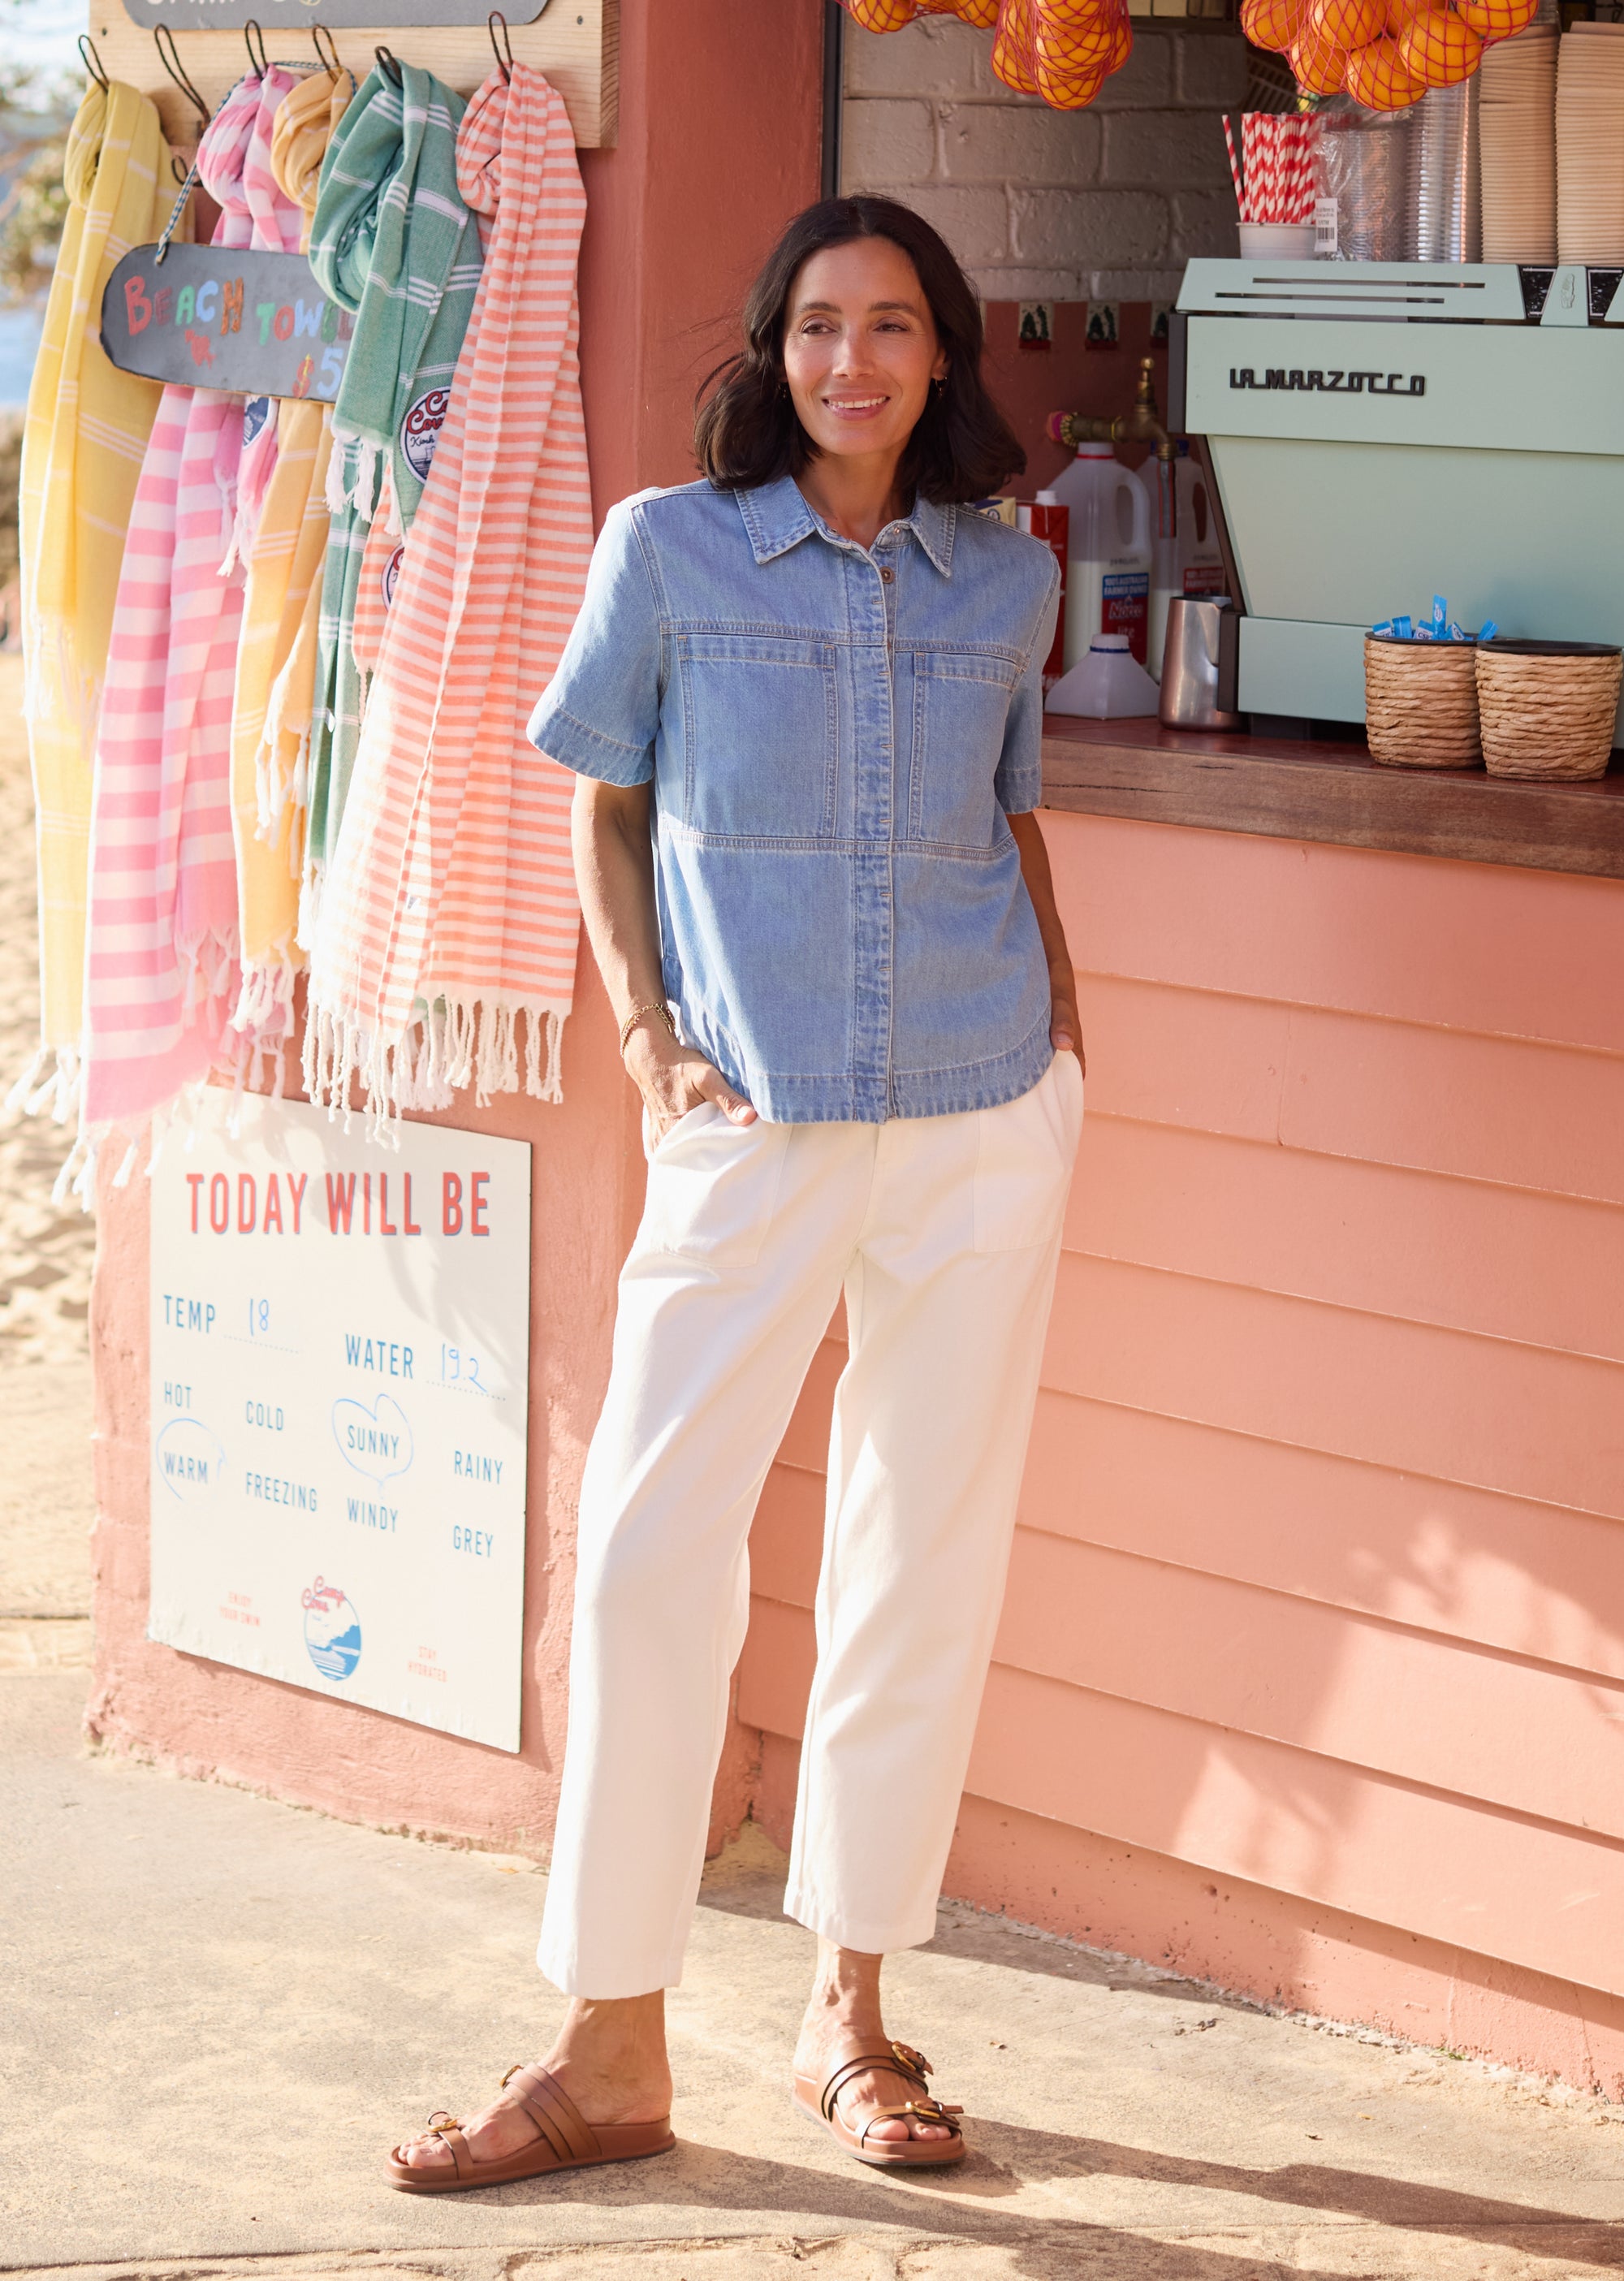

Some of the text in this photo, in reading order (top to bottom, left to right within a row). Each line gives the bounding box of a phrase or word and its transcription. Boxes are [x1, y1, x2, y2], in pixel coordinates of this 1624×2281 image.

[124, 276, 244, 336] BEACH
[1229, 369, 1425, 395] LA MARZOCCO
[407, 409, 444, 434] Cov
[186, 1172, 490, 1235] TODAY WILL BE
[163, 1294, 215, 1333] TEMP
[249, 1298, 269, 1337] 18
[345, 1333, 413, 1379] WATER
[164, 1381, 192, 1409] HOT
[246, 1401, 284, 1431] COLD
[348, 1425, 399, 1459] SUNNY
[164, 1451, 208, 1484] WARM
[455, 1450, 503, 1484] RAINY
[246, 1472, 317, 1512] FREEZING
[347, 1497, 398, 1532] WINDY
[453, 1525, 494, 1557] GREY
